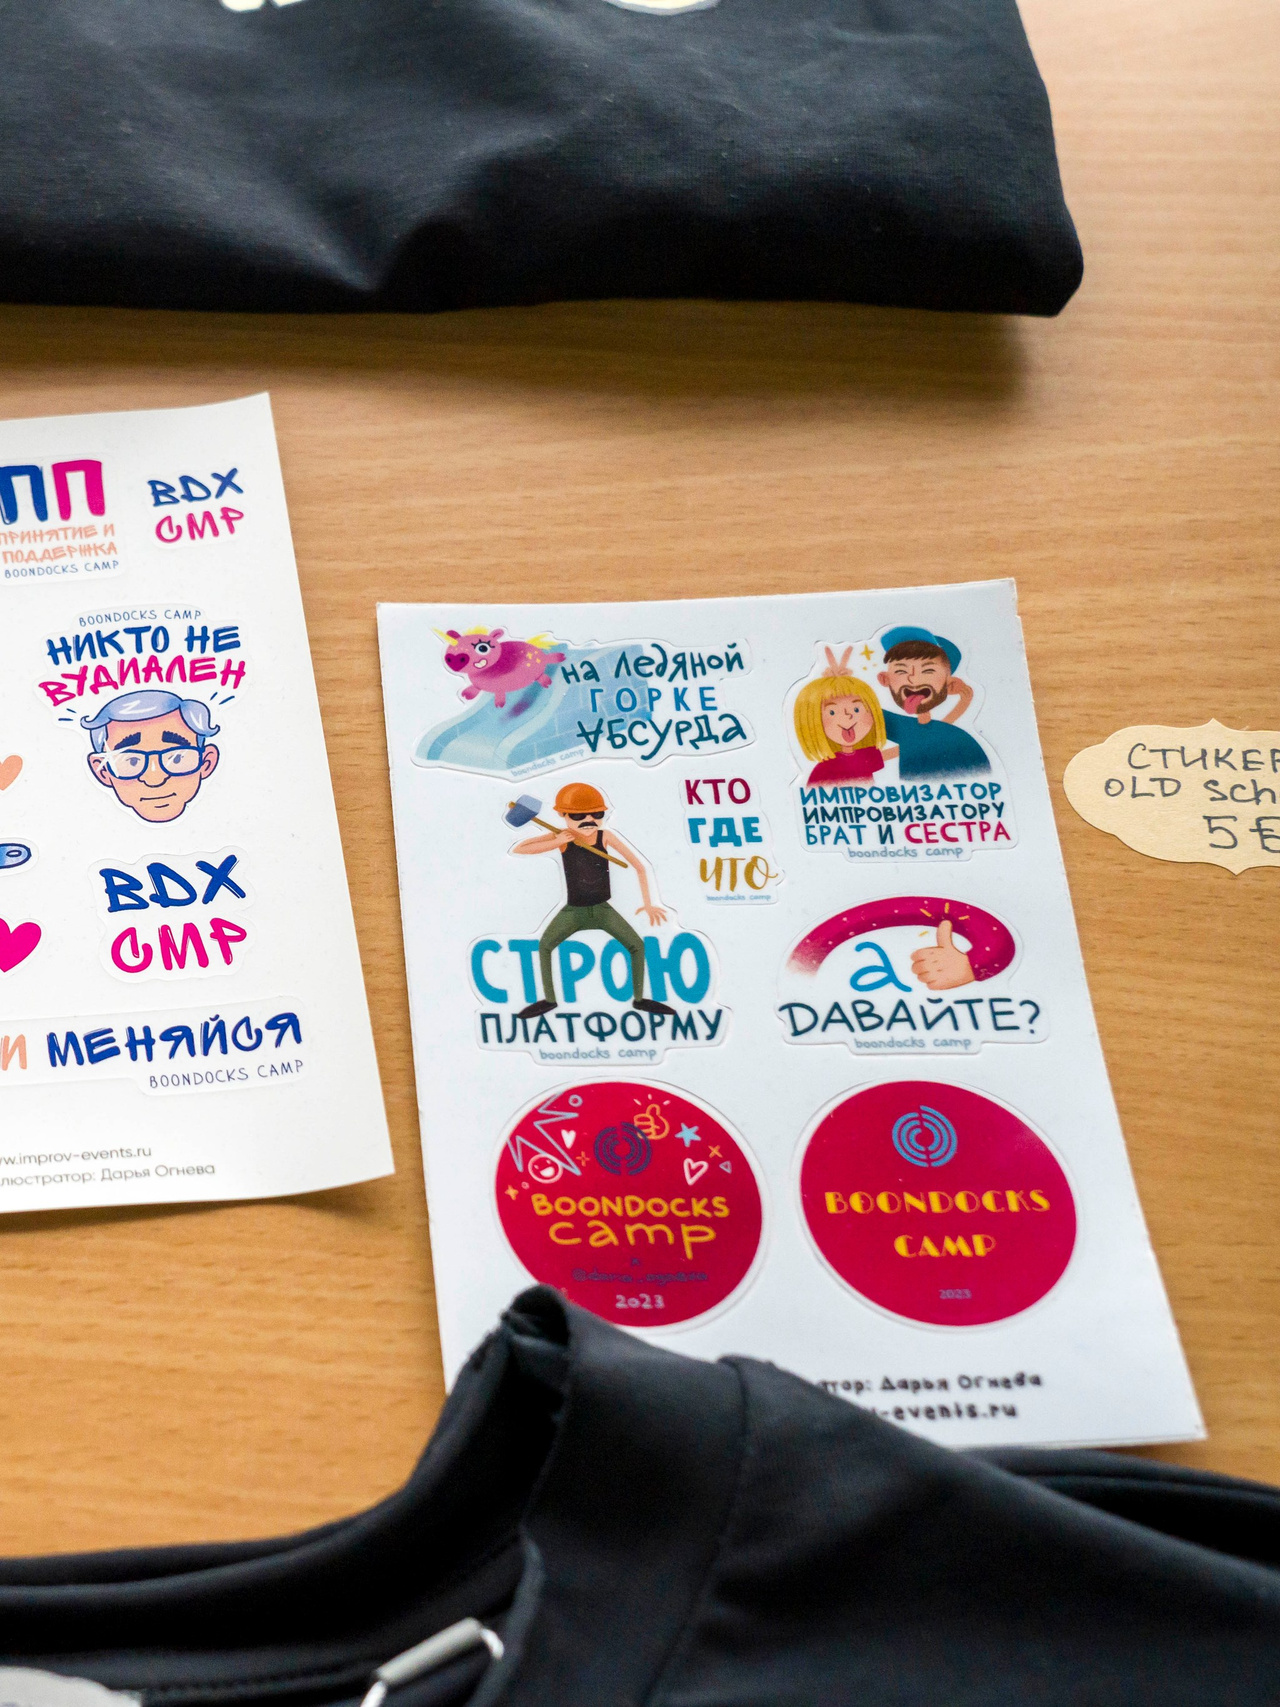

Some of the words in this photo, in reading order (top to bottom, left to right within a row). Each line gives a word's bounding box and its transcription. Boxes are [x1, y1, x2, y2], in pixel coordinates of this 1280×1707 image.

[147, 467, 244, 507] BDX
[103, 523, 115, 537] И
[155, 506, 245, 543] CMP
[2, 541, 118, 564] ПОДДЕРЖКА
[4, 564, 79, 579] BOONDOCKS
[84, 560, 120, 573] CAMP
[79, 609, 157, 627] BOONDOCKS
[164, 609, 202, 621] CAMP
[47, 626, 171, 666] НИКТО
[184, 626, 241, 654] НЕ
[562, 660, 600, 685] на
[614, 643, 745, 682] ледяной
[38, 654, 247, 707] ВУДИАЛЕН
[589, 686, 720, 713] ГОРКЕ
[511, 757, 556, 776] boondocks
[560, 749, 585, 761] camp
[685, 778, 751, 805] КТО
[800, 782, 1002, 806] ИМПРОВИЗАТОР
[1104, 776, 1181, 798] OLD
[802, 801, 1005, 825] ИМПРОВИЗАТОРУ
[688, 817, 763, 847] ГДЕ
[805, 824, 866, 846] БРАТ
[878, 824, 894, 845] И
[904, 821, 1011, 844] СЕСТРА
[848, 846, 918, 859] boondocks
[925, 845, 963, 859] camp
[99, 854, 246, 913] BDX
[110, 917, 248, 974] CMP
[471, 932, 711, 1004] СТРОЮ
[480, 1008, 723, 1044] ПЛАТФОРМУ
[778, 997, 1040, 1037] ДАВАЙТЕ?
[0, 1034, 28, 1071] И
[46, 1012, 303, 1068] МЕНЯЙСЯ
[539, 1047, 610, 1060] boondocks
[618, 1048, 657, 1061] camp
[854, 1037, 926, 1050] boondocks
[933, 1037, 972, 1051] camp
[149, 1067, 249, 1089] BOONDOCKS
[257, 1059, 304, 1078] CAMP
[100, 1167, 151, 1183] Дарья
[154, 1164, 216, 1178] Огнева
[531, 1193, 730, 1218] BOONDOCKS
[824, 1189, 1050, 1214] BOONDOCKS
[894, 1234, 996, 1258] CAMP
[615, 1294, 665, 1309] 2023
[880, 1375, 948, 1394] Дарья
[958, 1372, 1042, 1390] Огнева
[872, 1402, 1017, 1420] -events.ru
